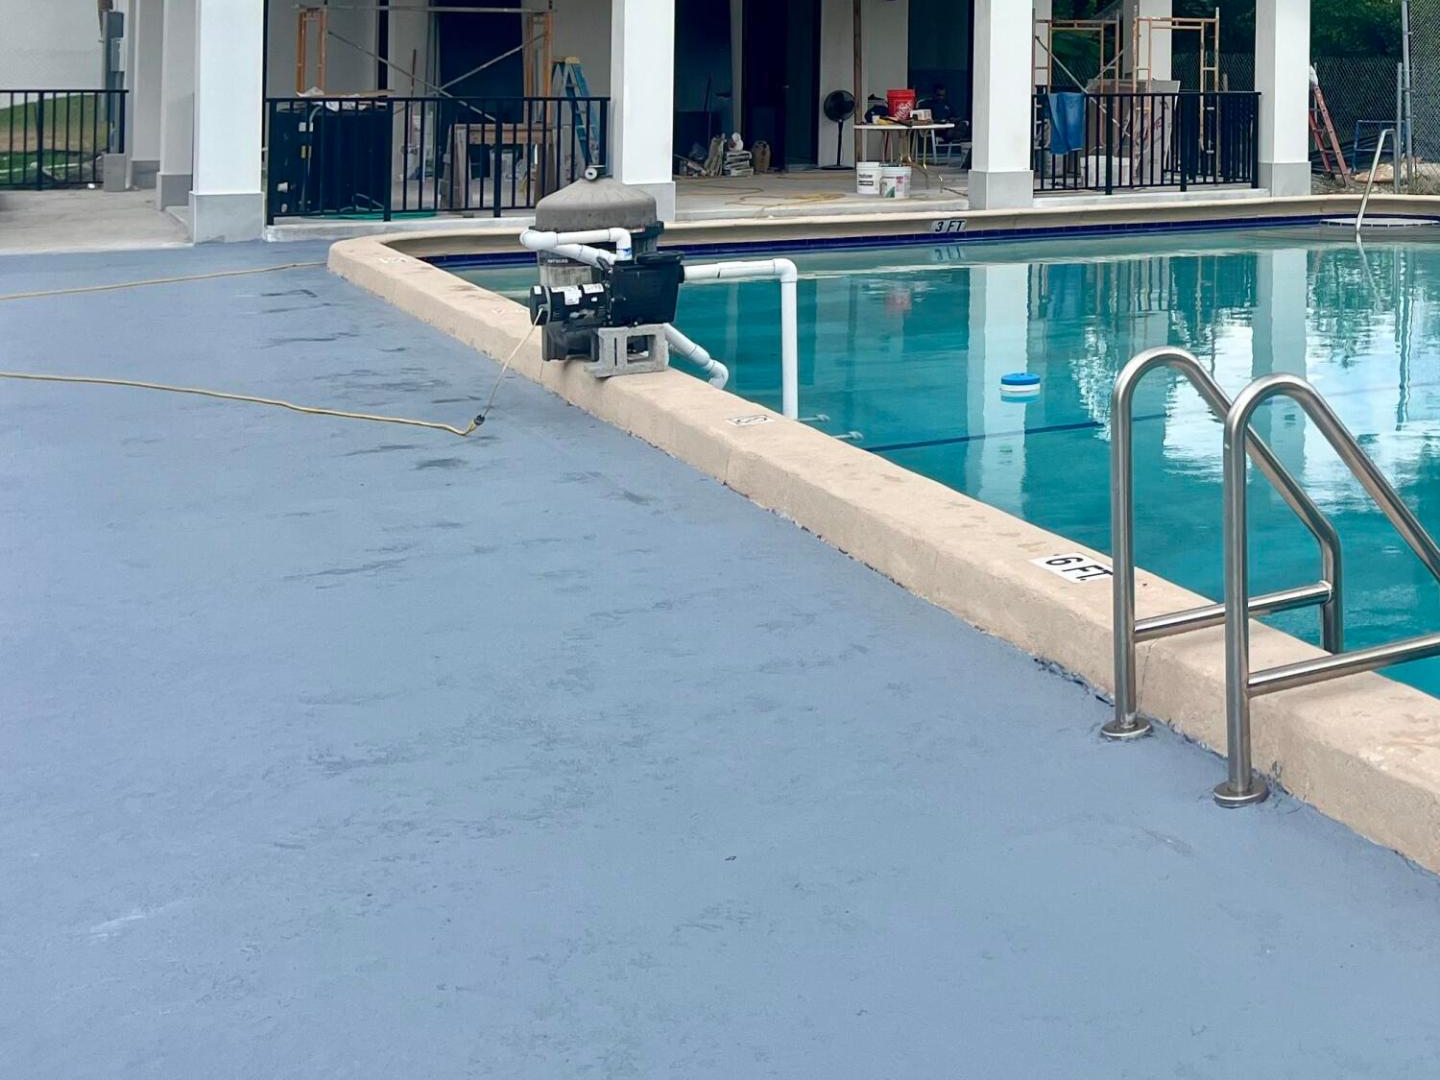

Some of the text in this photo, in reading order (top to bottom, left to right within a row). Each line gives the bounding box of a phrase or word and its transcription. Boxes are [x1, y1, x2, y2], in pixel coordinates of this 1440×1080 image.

[935, 220, 966, 232] 3 FT
[1046, 556, 1084, 566] 6
